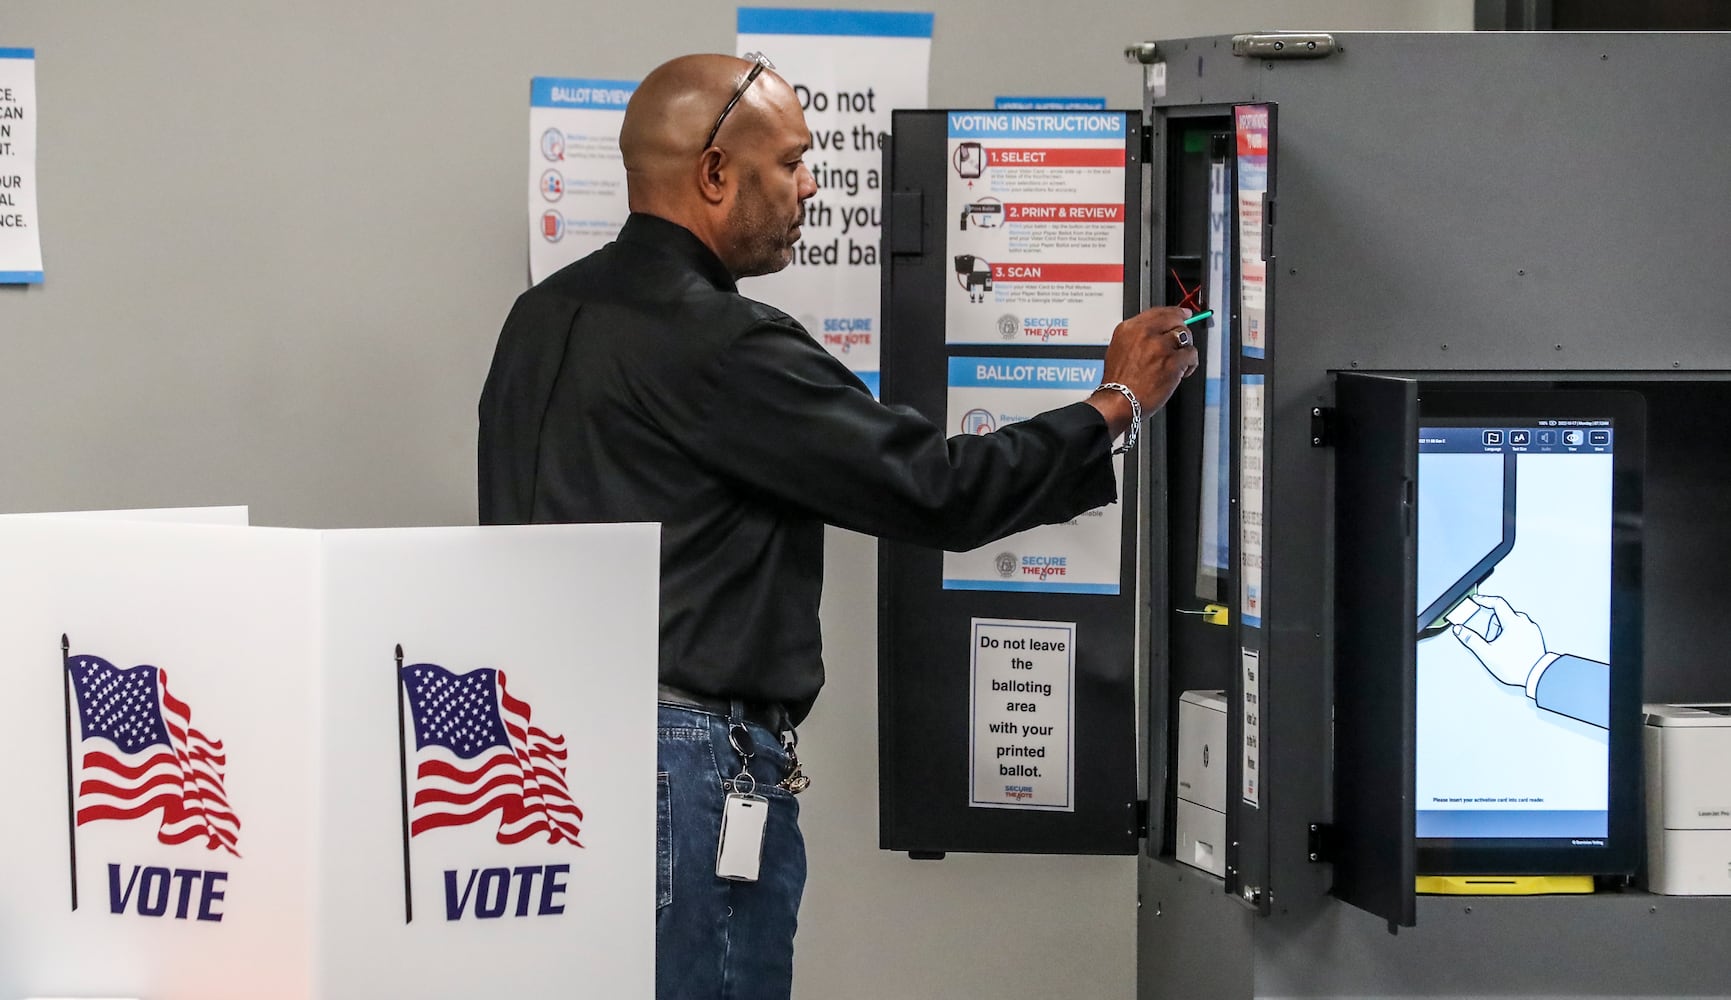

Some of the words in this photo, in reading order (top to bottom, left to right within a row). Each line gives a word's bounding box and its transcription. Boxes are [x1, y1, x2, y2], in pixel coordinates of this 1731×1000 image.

[551, 87, 590, 103] BALLOT
[837, 87, 876, 113] not
[952, 116, 1008, 132] VOTING
[1012, 117, 1120, 133] INSTRUCTIONS
[992, 153, 999, 162] 1.
[1001, 152, 1047, 162] SELECT
[1010, 208, 1019, 218] 2.
[1022, 208, 1056, 218] PRINT
[1059, 208, 1067, 218] &
[1070, 208, 1118, 218] REVIEW
[995, 268, 1005, 278] 3.
[1008, 268, 1042, 278] SCAN
[823, 318, 872, 332] SECURE
[1024, 318, 1068, 327] SECURE
[976, 366, 1034, 381] BALLOT
[1037, 367, 1096, 381] REVIEW
[1022, 556, 1067, 566] SECURE
[981, 636, 999, 649] Do
[1003, 638, 1025, 650] not
[1030, 639, 1065, 651] leave
[1011, 658, 1033, 670] the
[992, 680, 1052, 697] balloting
[1007, 702, 1036, 712] area
[989, 722, 1017, 734] with
[1022, 725, 1053, 738] your
[997, 745, 1045, 759] printed
[1000, 764, 1042, 778] ballot.
[1005, 785, 1032, 793] SECURE
[108, 863, 229, 922] VOTE
[443, 864, 570, 921] VOTE
